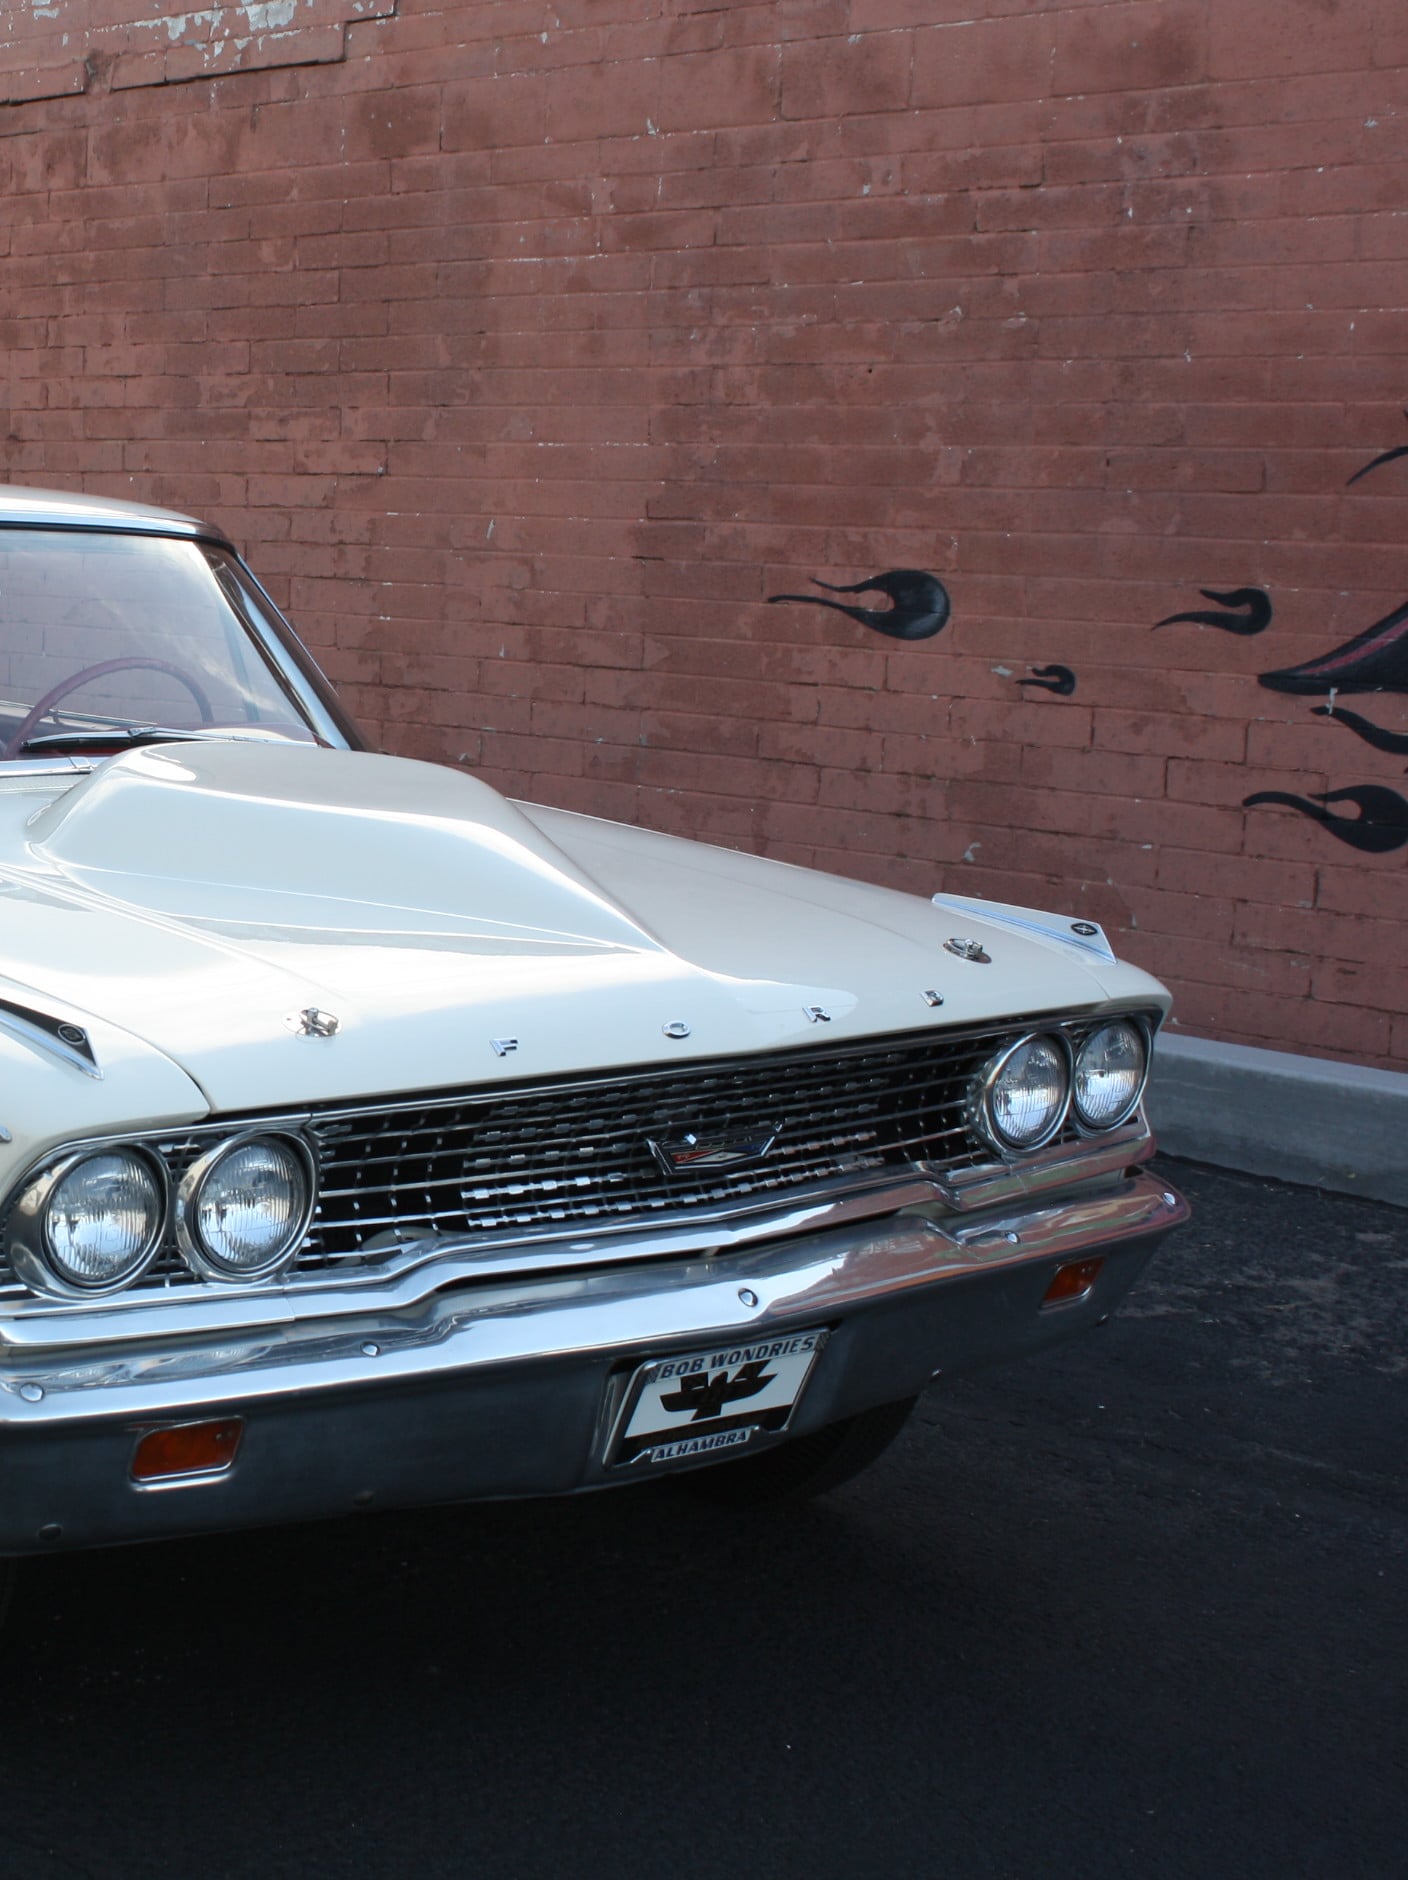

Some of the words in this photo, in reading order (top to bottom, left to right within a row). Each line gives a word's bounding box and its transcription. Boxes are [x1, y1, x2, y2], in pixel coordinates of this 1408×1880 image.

[660, 1358, 705, 1379] BOB
[710, 1336, 815, 1369] WONDRIES
[654, 1430, 748, 1461] ALHAMBRA
